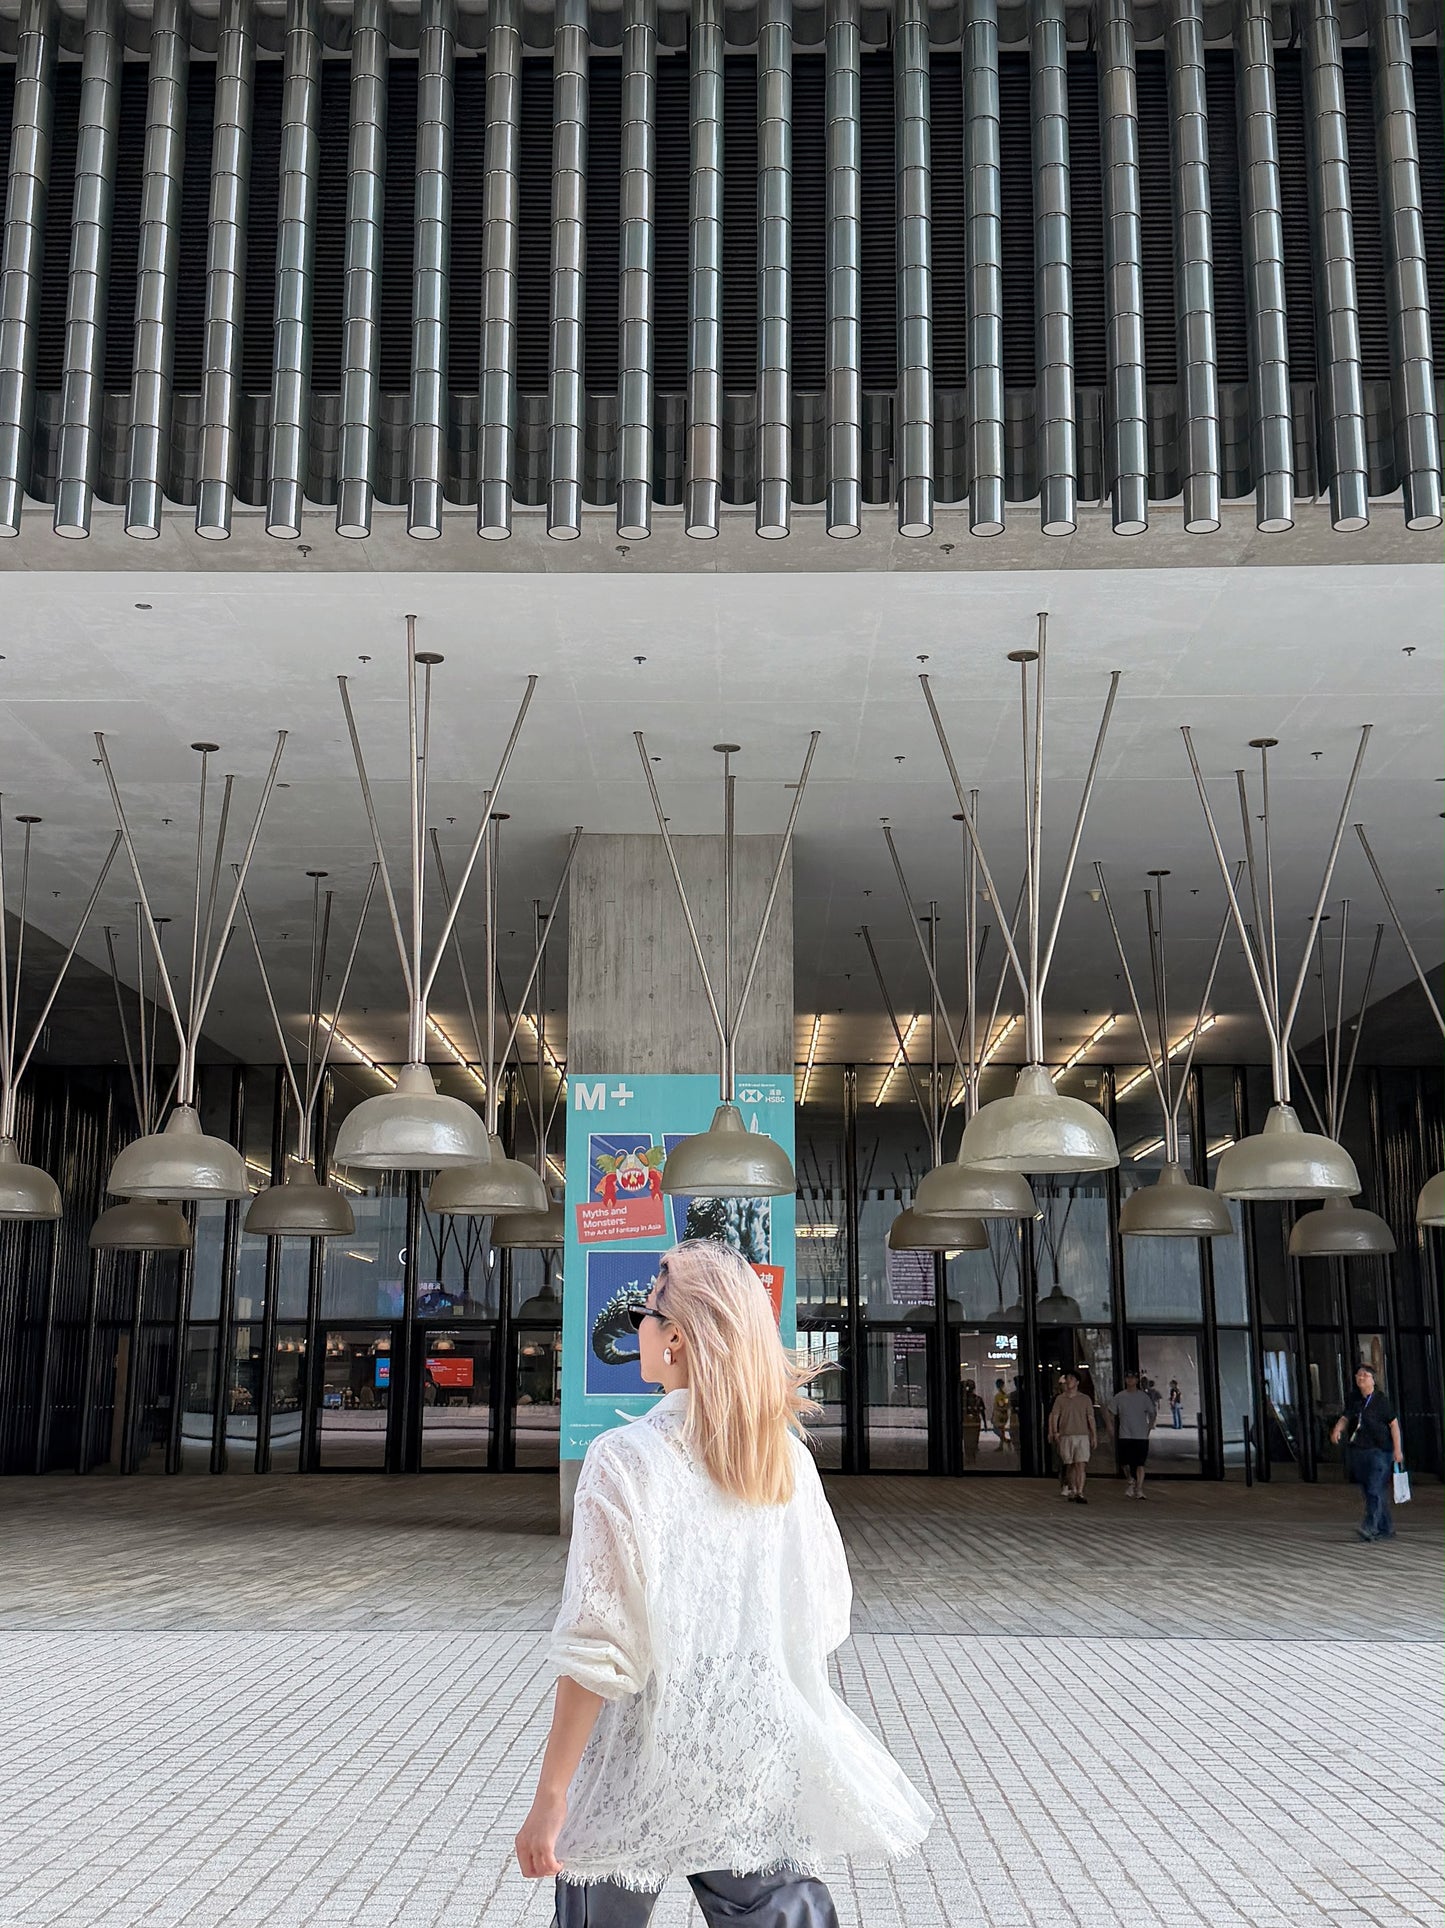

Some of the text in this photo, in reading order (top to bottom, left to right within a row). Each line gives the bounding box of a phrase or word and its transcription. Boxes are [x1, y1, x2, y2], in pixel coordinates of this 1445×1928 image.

[575, 1082, 634, 1111] M+
[582, 1206, 627, 1219] Myths and
[583, 1218, 627, 1228] Monsters:
[616, 1226, 640, 1234] Fantasy
[987, 1352, 1016, 1360] Learning
